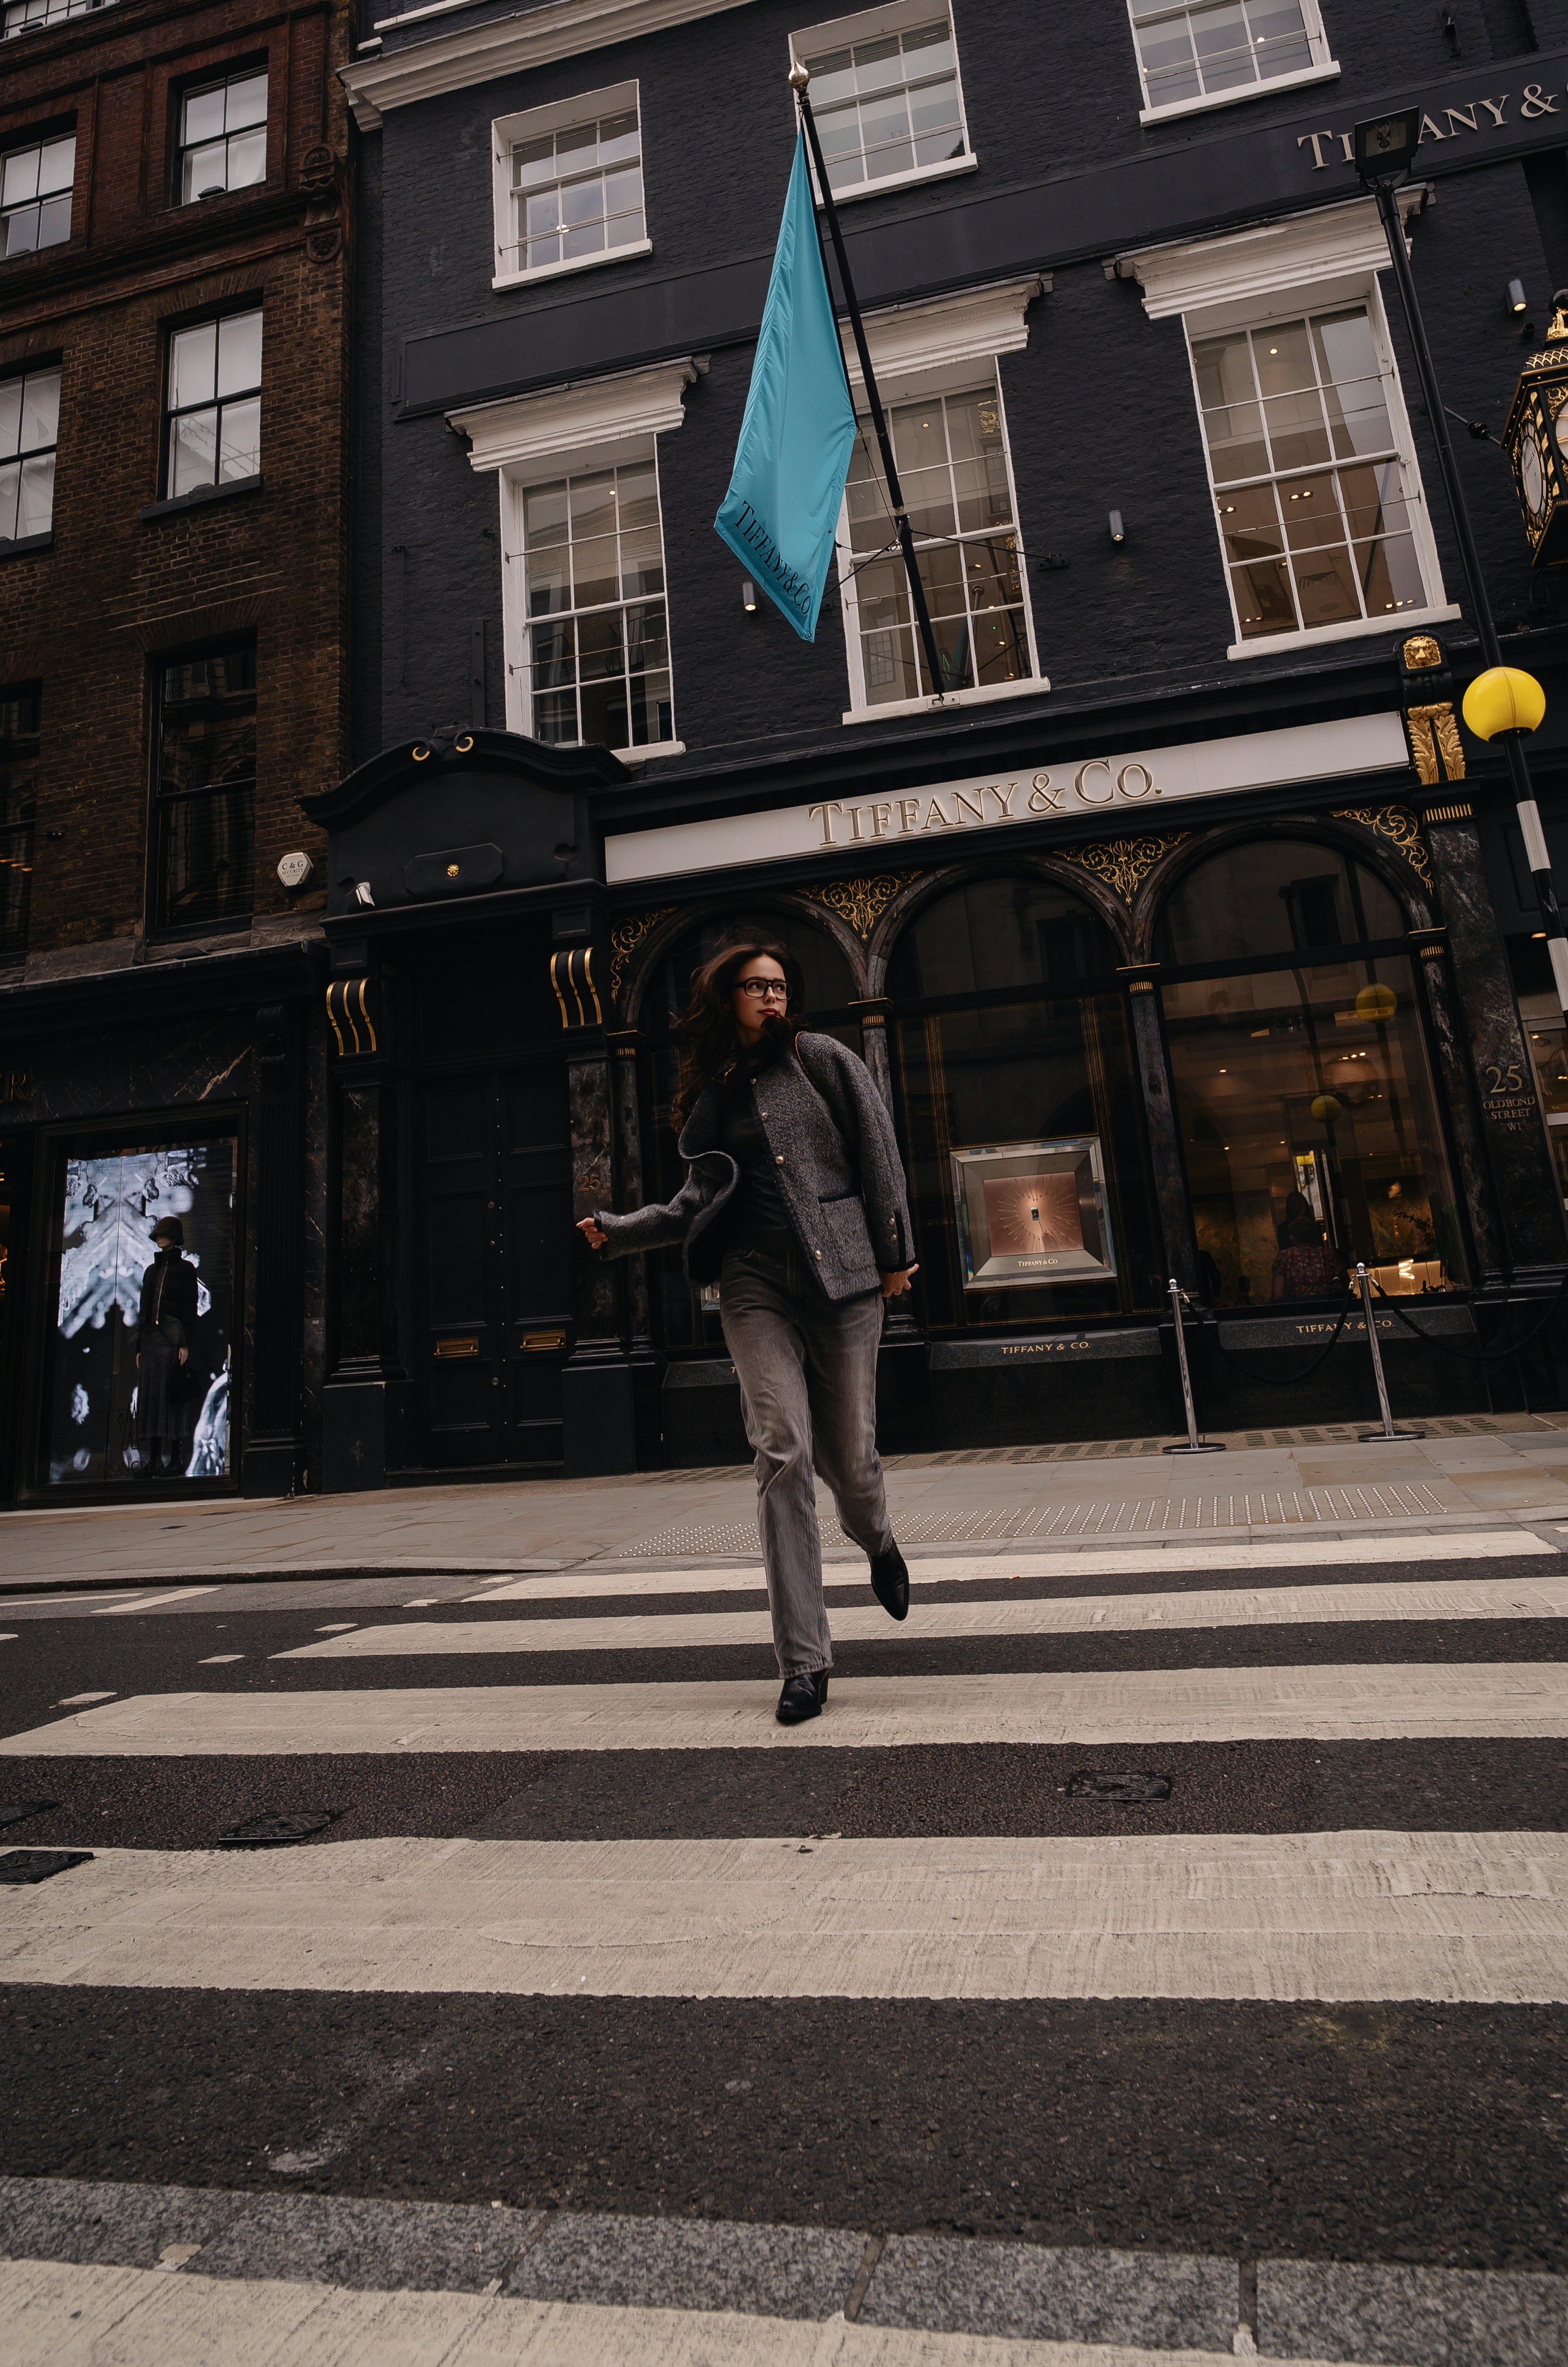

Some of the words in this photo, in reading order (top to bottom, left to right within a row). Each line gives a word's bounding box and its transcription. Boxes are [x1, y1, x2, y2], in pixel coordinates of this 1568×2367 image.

[1297, 94, 1510, 170] TIANY
[1520, 84, 1561, 118] &
[734, 500, 792, 582] TIFFANY
[808, 782, 1019, 846] TIFFANY
[1027, 773, 1067, 814] &
[1486, 1065, 1522, 1094] 25
[1483, 1101, 1505, 1109] OLD
[1506, 1097, 1535, 1107] BOND
[1491, 1108, 1531, 1120] STREET
[579, 1174, 601, 1192] 25
[1001, 1344, 1053, 1354] TIFFANY
